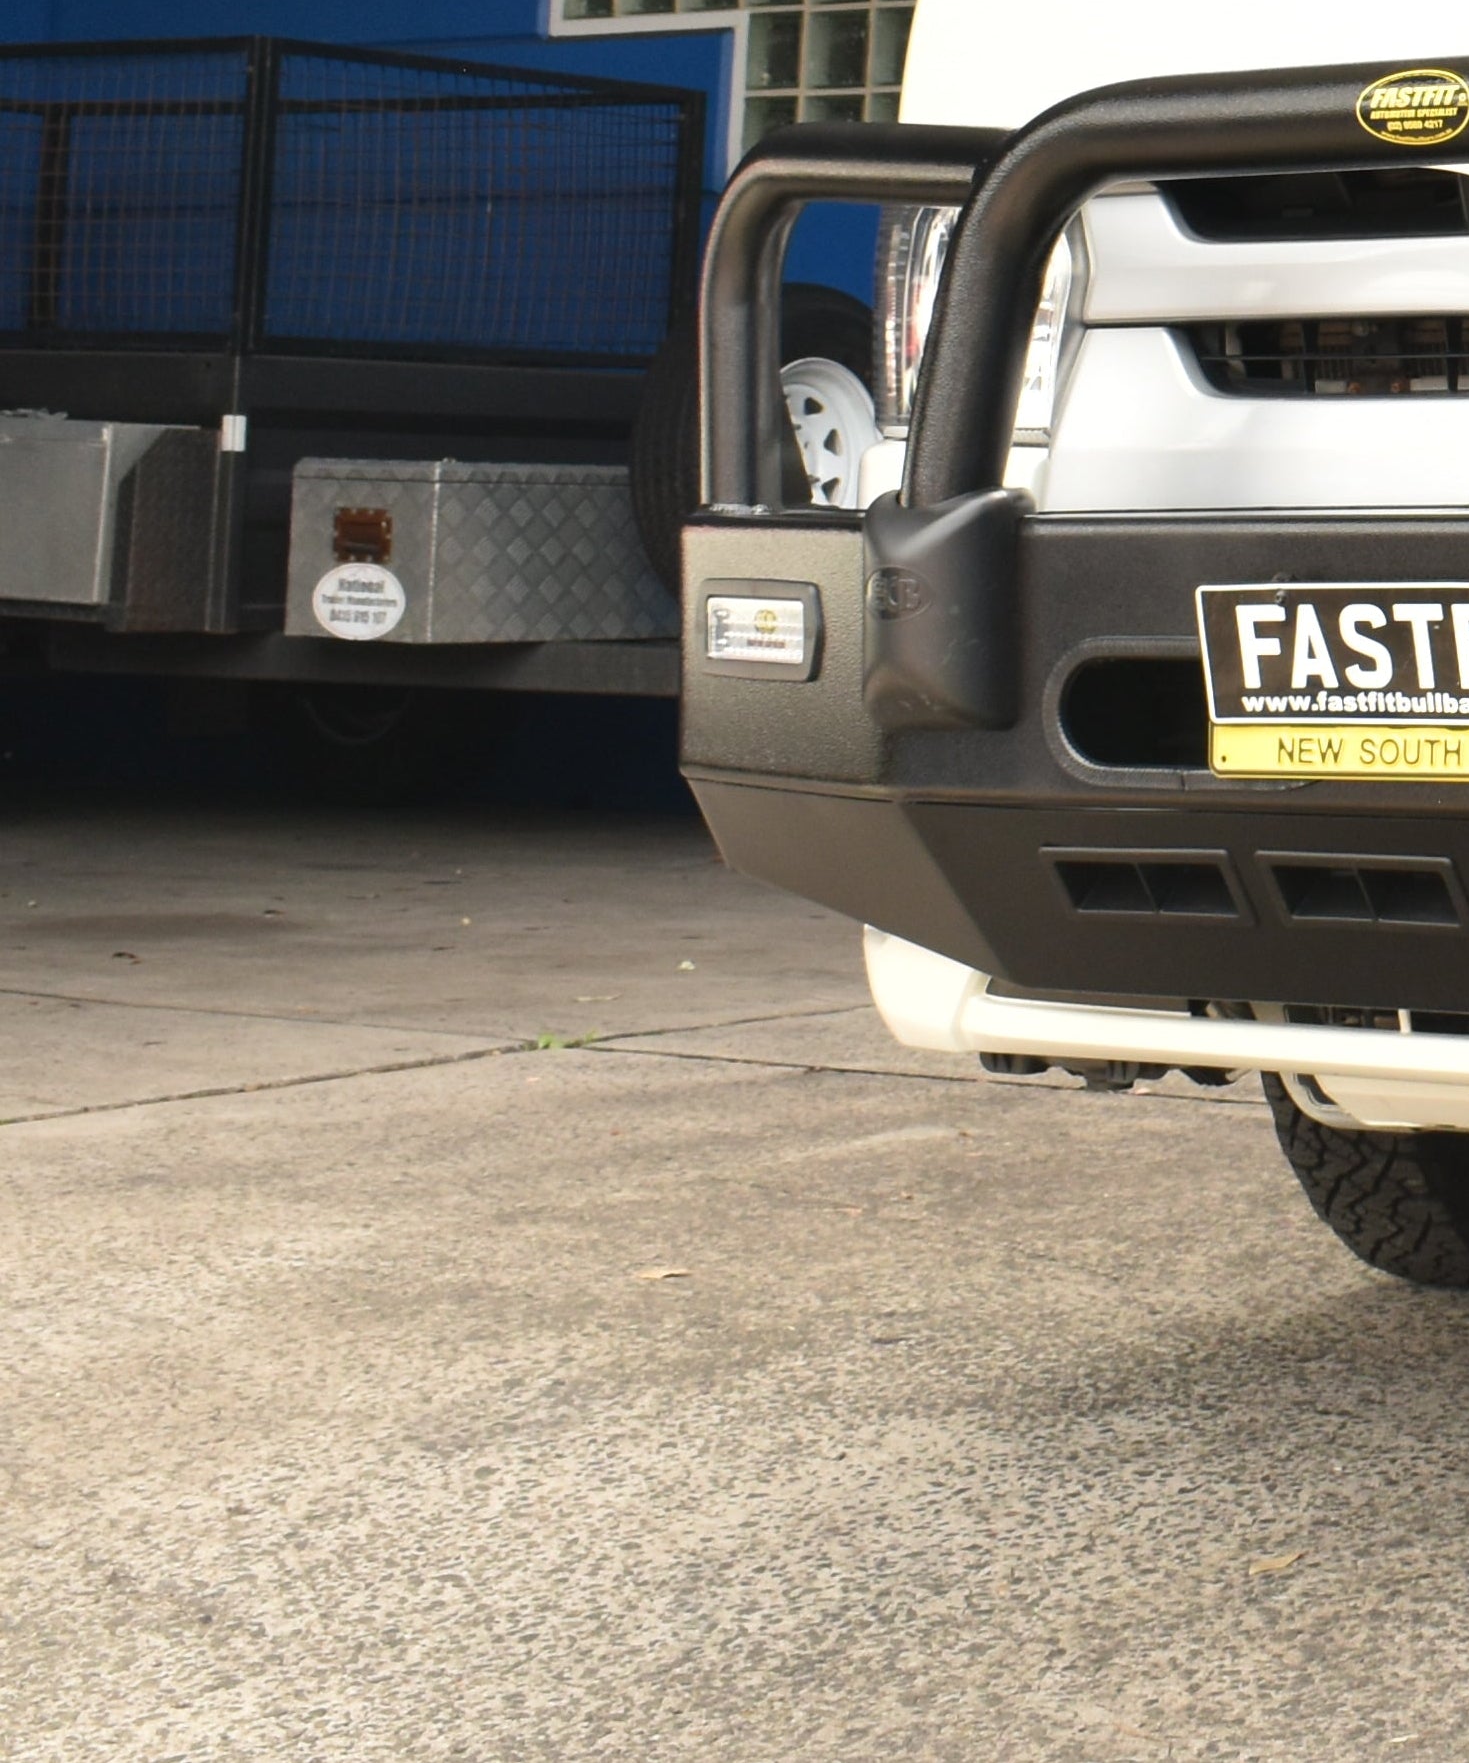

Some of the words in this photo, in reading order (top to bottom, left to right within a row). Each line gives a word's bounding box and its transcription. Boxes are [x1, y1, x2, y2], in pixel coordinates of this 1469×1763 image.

[1370, 84, 1461, 109] FASTFIT
[1278, 737, 1344, 764] NEW
[1359, 738, 1461, 766] SOUTH
